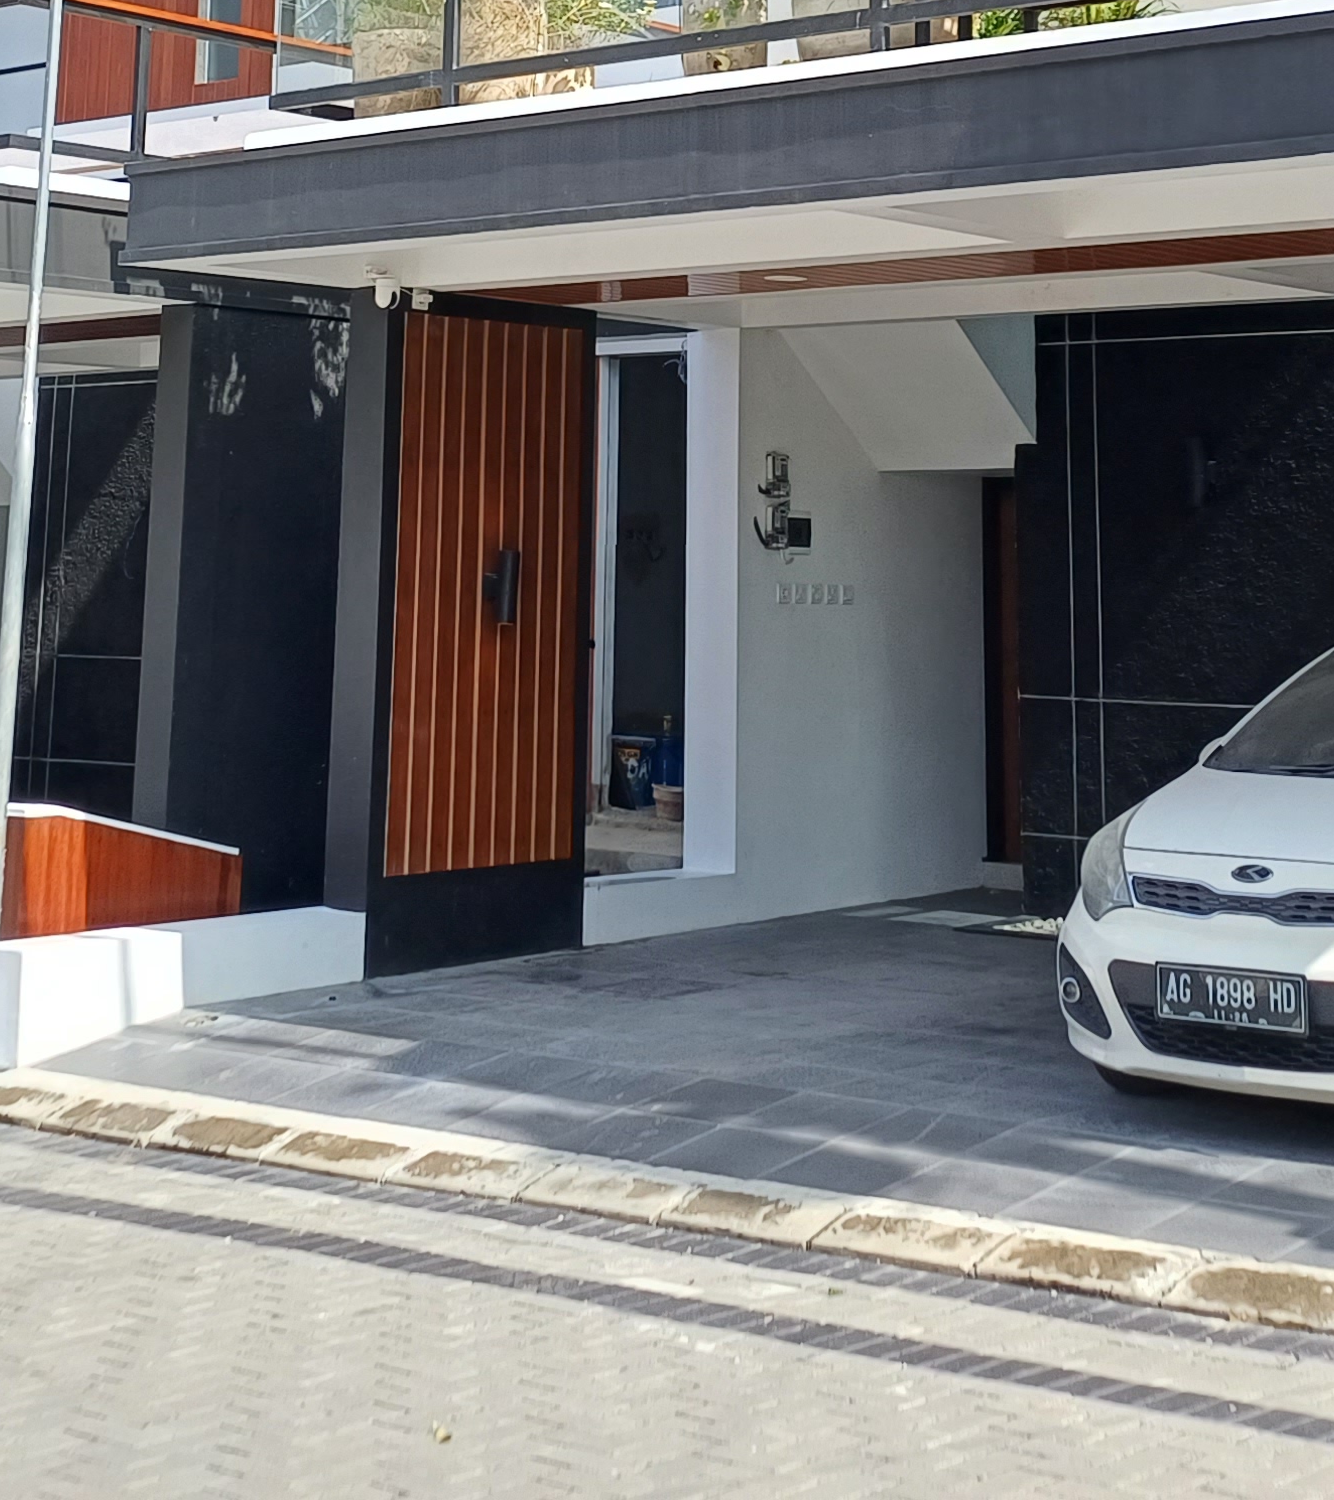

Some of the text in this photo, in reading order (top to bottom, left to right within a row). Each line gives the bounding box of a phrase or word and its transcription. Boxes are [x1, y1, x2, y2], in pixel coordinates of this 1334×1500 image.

[1165, 971, 1296, 1014] AG 1898 HD
